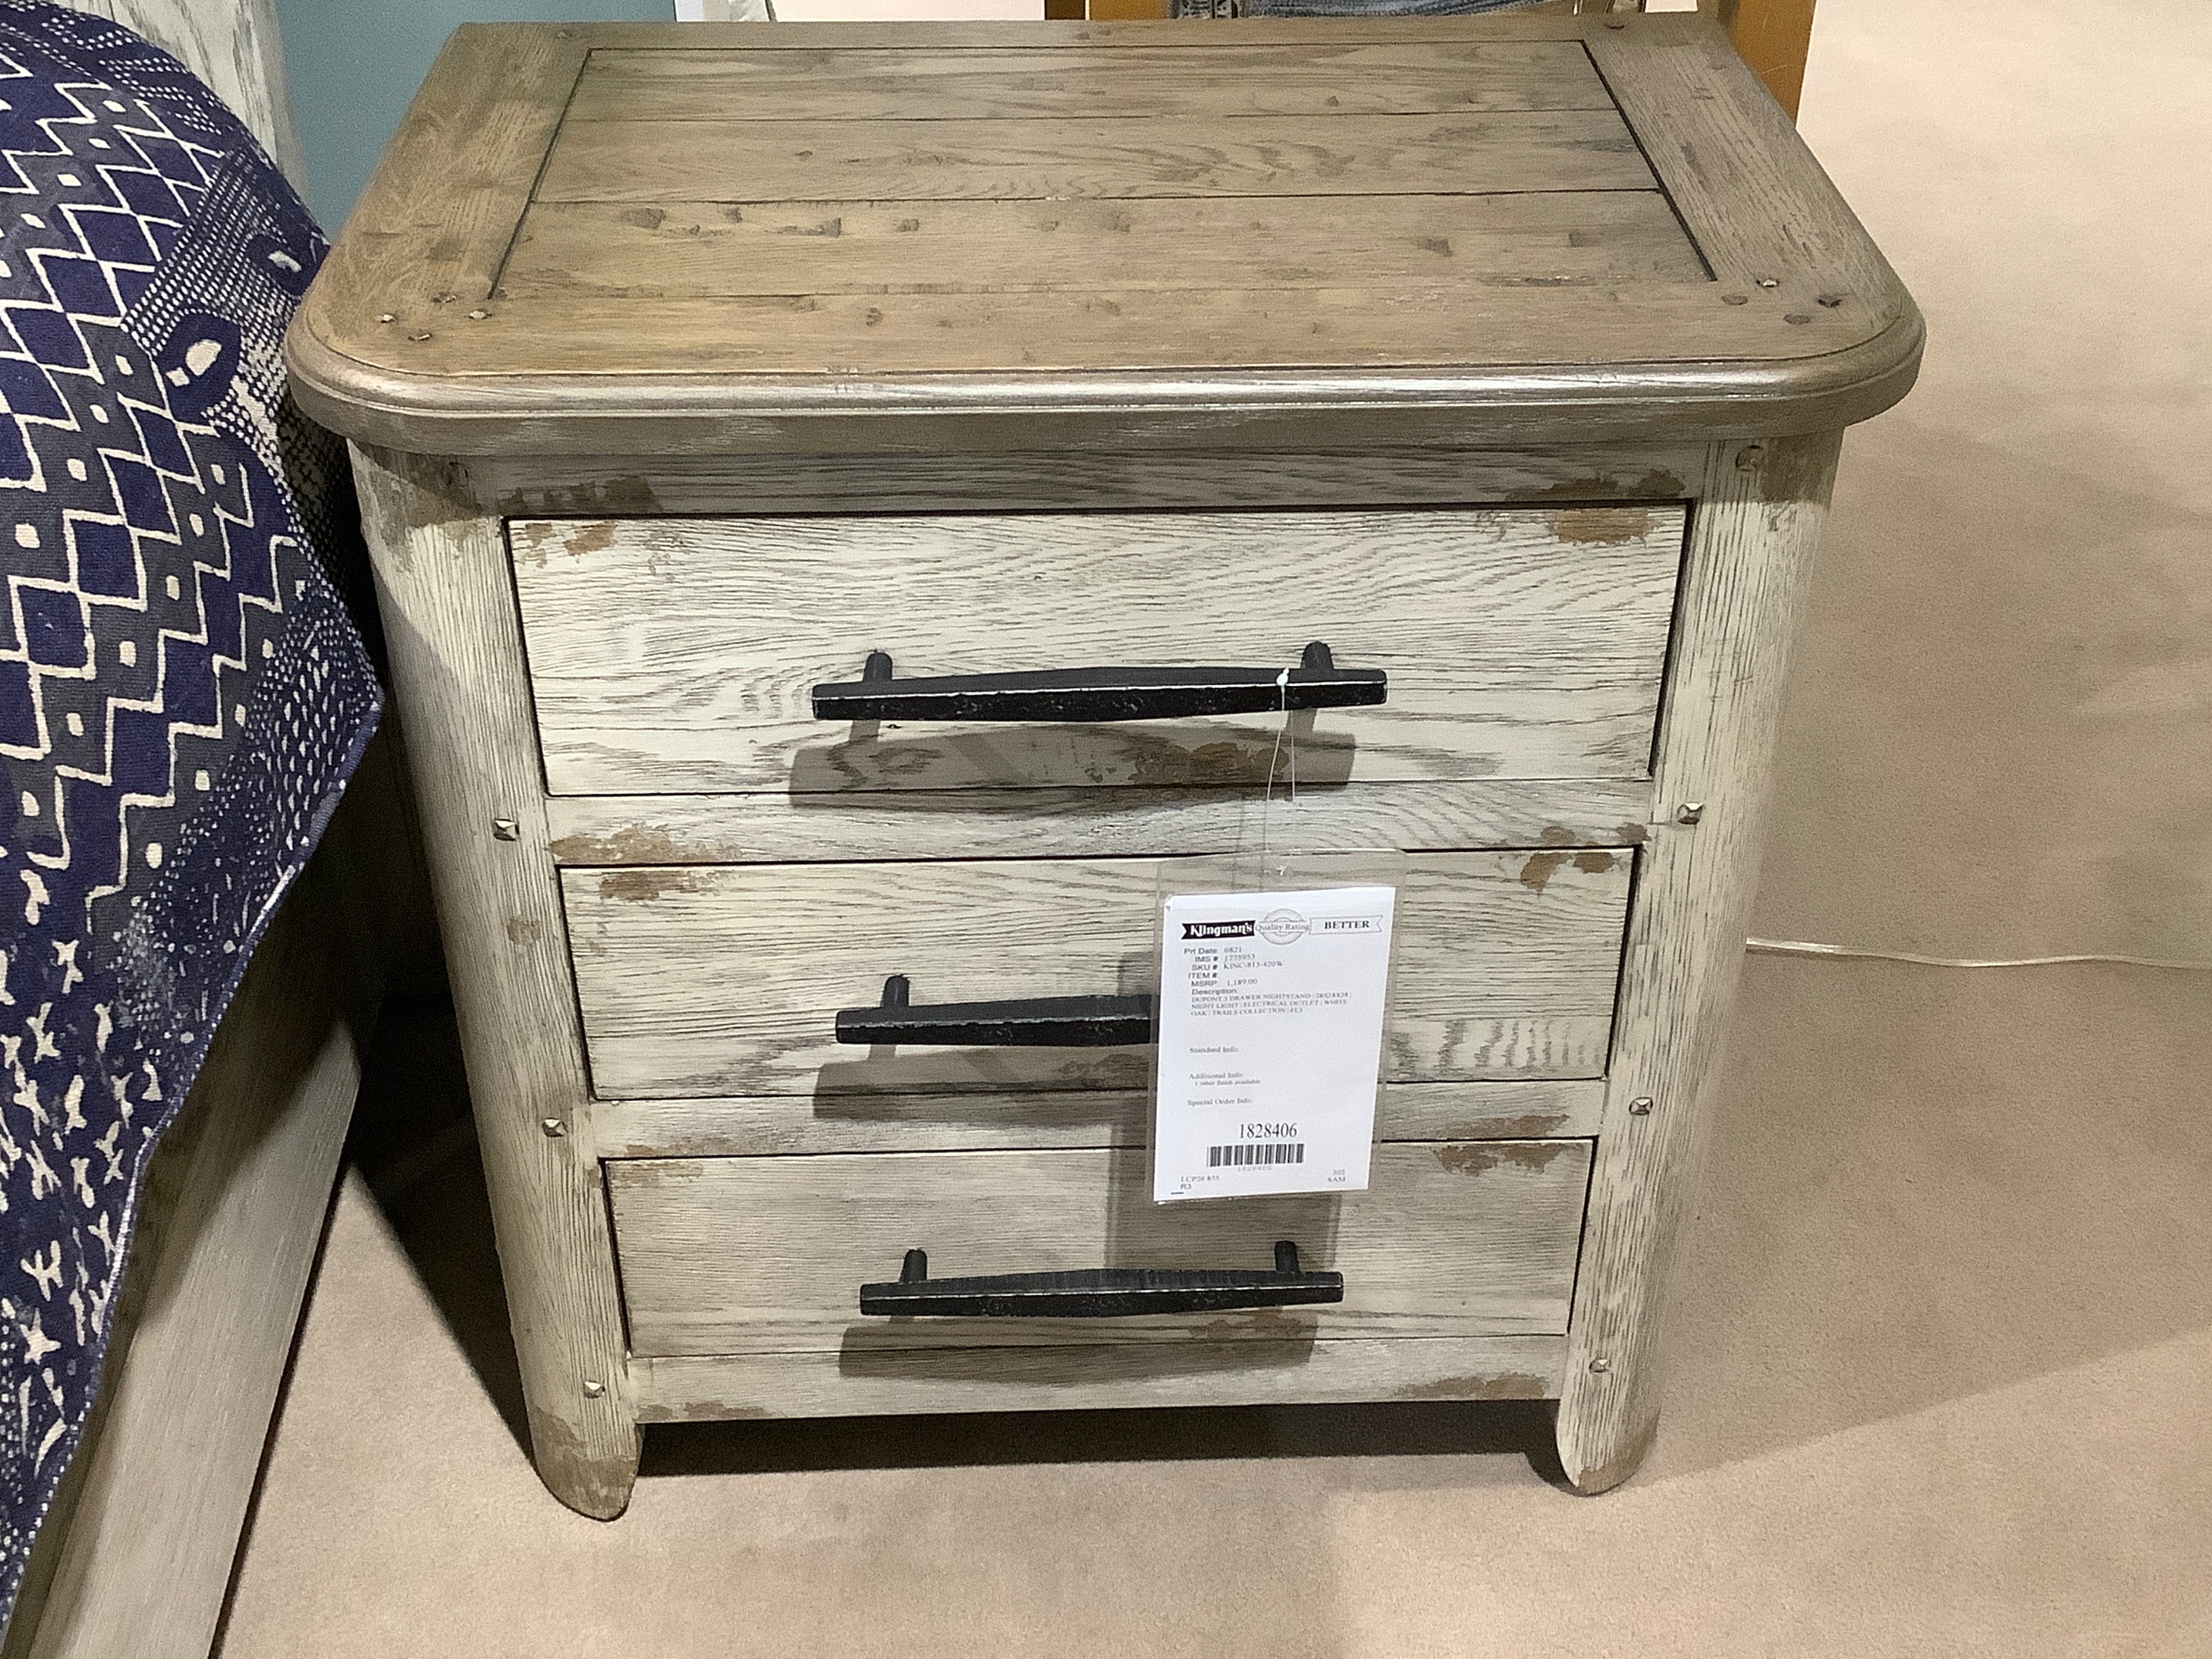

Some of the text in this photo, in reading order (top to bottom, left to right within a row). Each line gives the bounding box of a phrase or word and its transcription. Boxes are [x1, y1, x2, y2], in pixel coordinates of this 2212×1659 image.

[1190, 922, 1252, 937] Klingman's
[1255, 921, 1311, 932] Quality Rating
[1324, 920, 1370, 929] BETTER
[1240, 1122, 1297, 1138] 1828406
